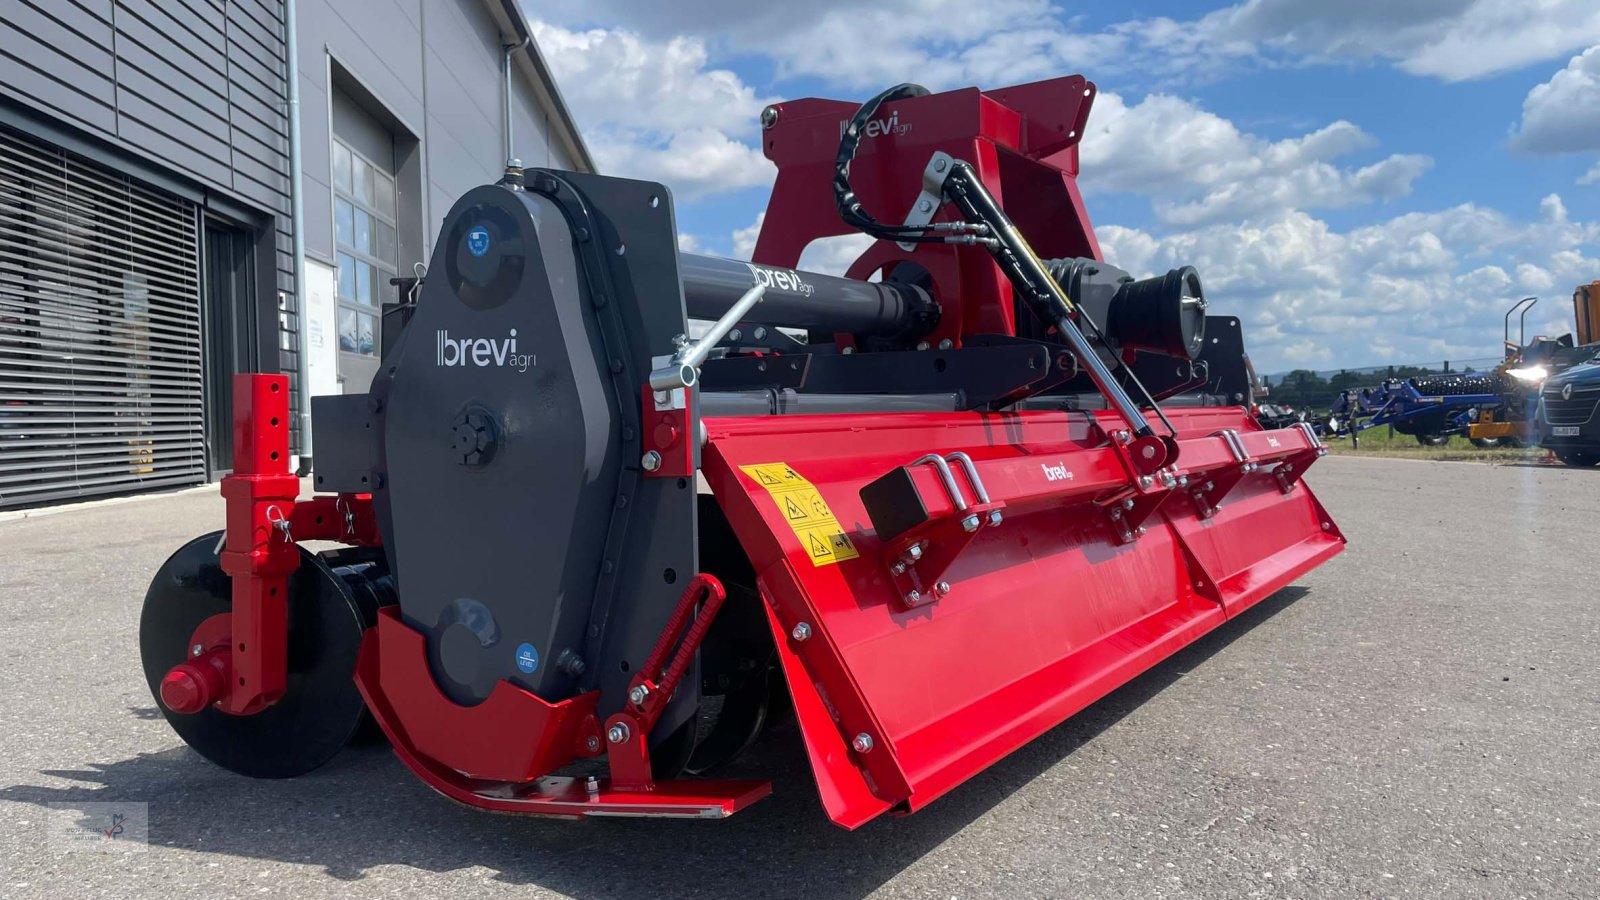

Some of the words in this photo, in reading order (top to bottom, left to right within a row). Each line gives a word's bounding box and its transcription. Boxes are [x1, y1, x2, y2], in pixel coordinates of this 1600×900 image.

[839, 110, 898, 141] evi
[745, 262, 801, 291] brevi
[437, 328, 517, 367] brevi
[509, 354, 537, 373] agri
